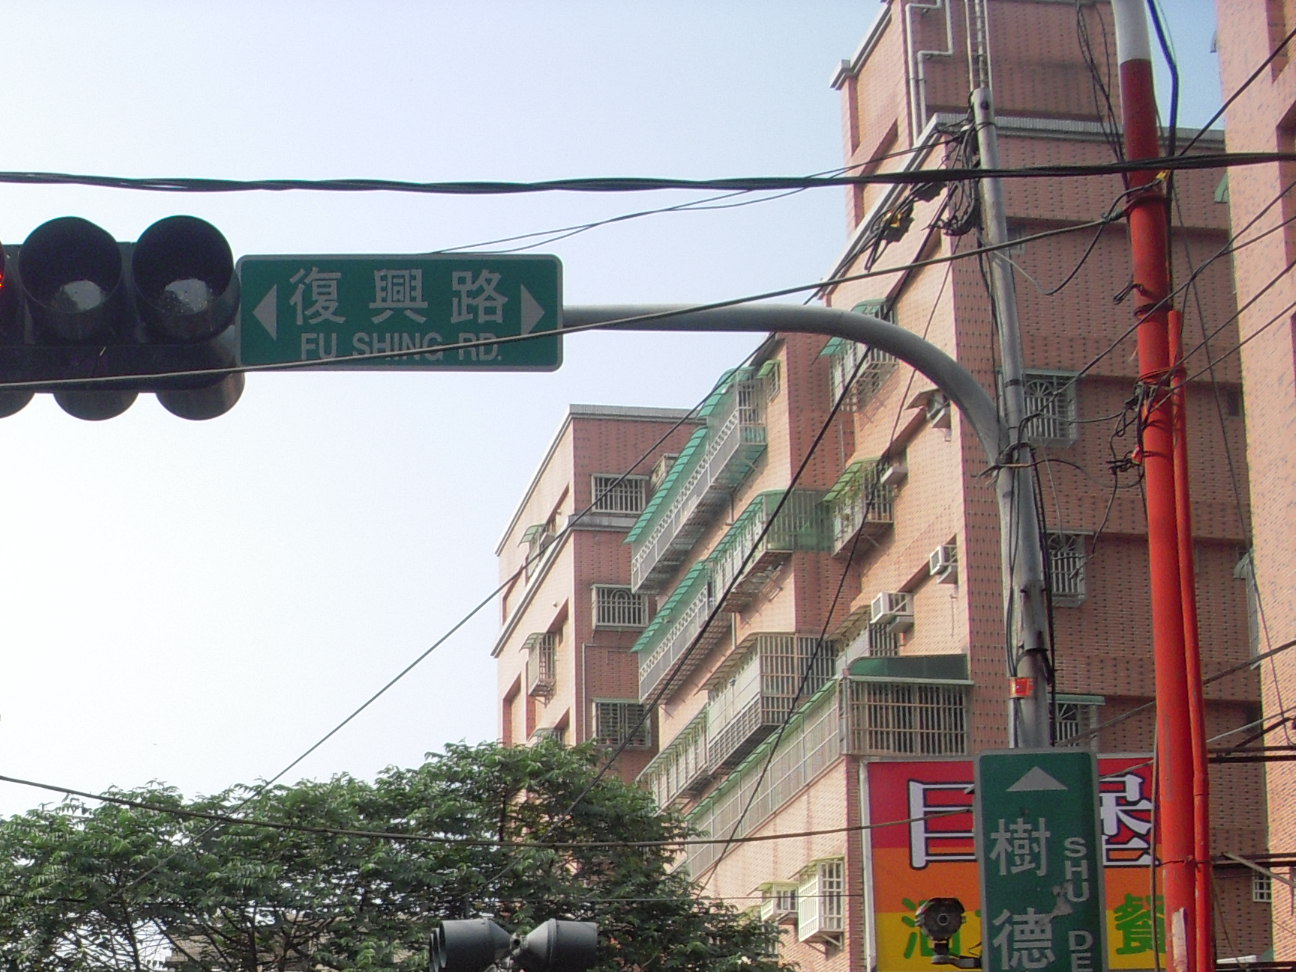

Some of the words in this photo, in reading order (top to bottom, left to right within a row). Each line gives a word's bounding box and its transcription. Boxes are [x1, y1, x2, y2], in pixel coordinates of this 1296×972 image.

[289, 267, 508, 325] 復興路
[301, 333, 337, 360] FU
[352, 332, 442, 361] SHING
[458, 332, 502, 361] RD.
[1064, 836, 1090, 902] SHU
[1068, 930, 1093, 972] DE
